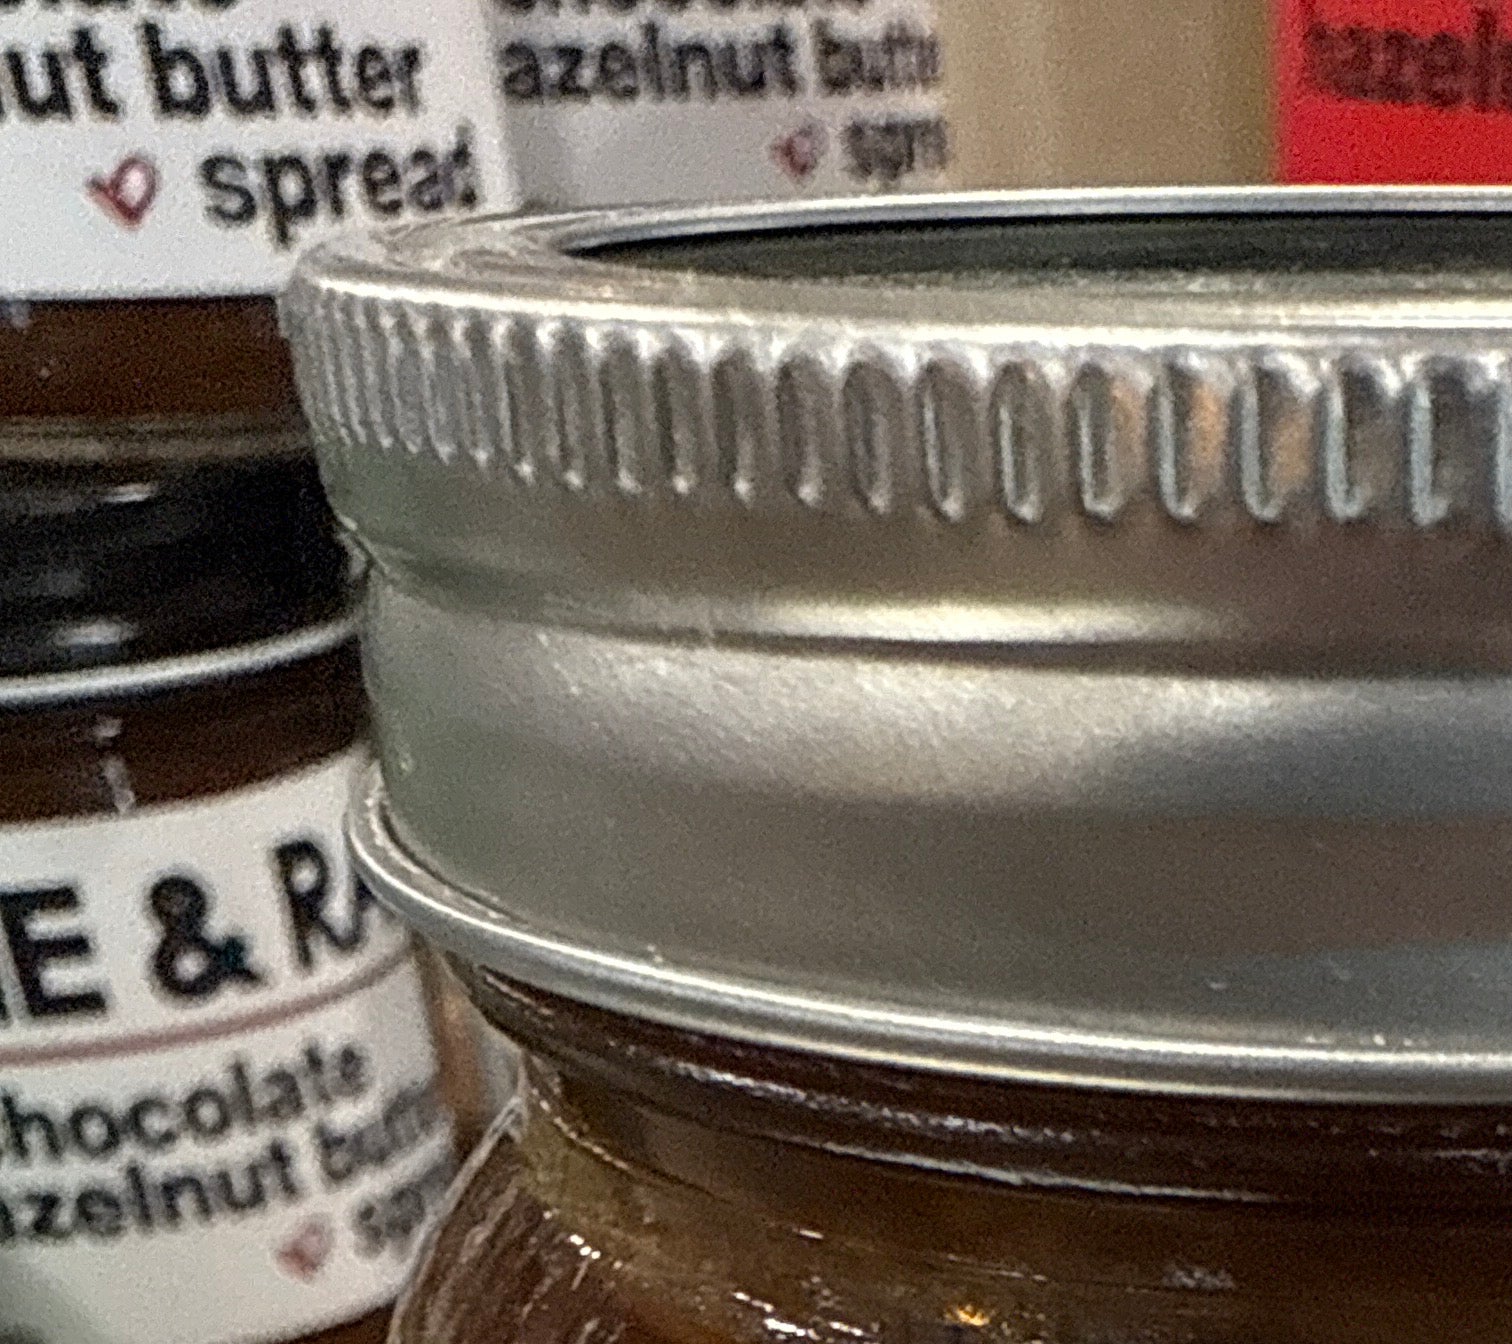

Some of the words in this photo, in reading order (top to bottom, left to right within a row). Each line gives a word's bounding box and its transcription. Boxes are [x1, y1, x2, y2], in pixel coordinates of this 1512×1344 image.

[0, 24, 119, 120] ut
[141, 20, 421, 119] butter
[502, 20, 802, 101] azelnut
[0, 885, 106, 1022] E
[150, 876, 262, 996] &
[274, 838, 378, 970] R
[0, 1040, 366, 1165] hocolate
